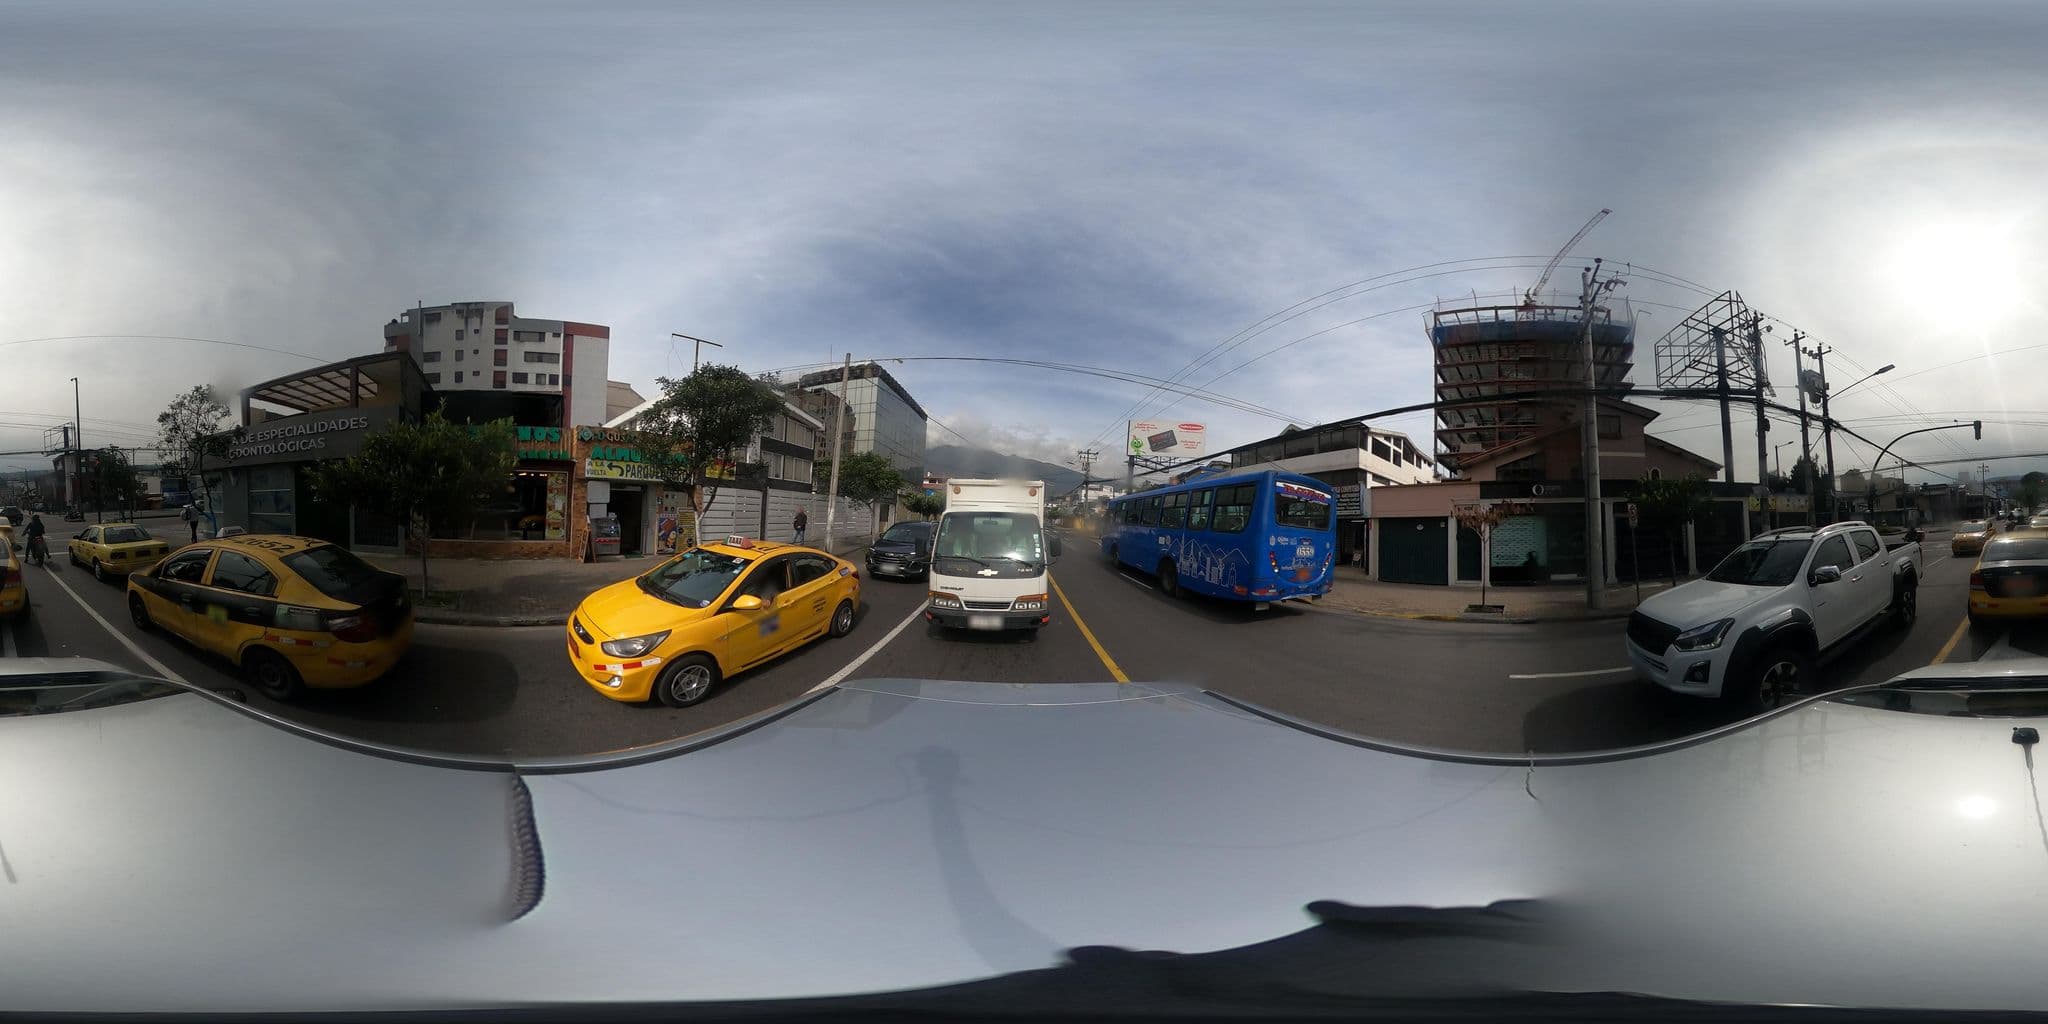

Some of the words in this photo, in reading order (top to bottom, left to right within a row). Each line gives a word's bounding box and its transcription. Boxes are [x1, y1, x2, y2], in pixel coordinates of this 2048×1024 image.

[257, 416, 368, 441] ESPECIALIDADES
[228, 437, 326, 460] ODONTOLÓGICAS
[729, 536, 742, 545] TAXI
